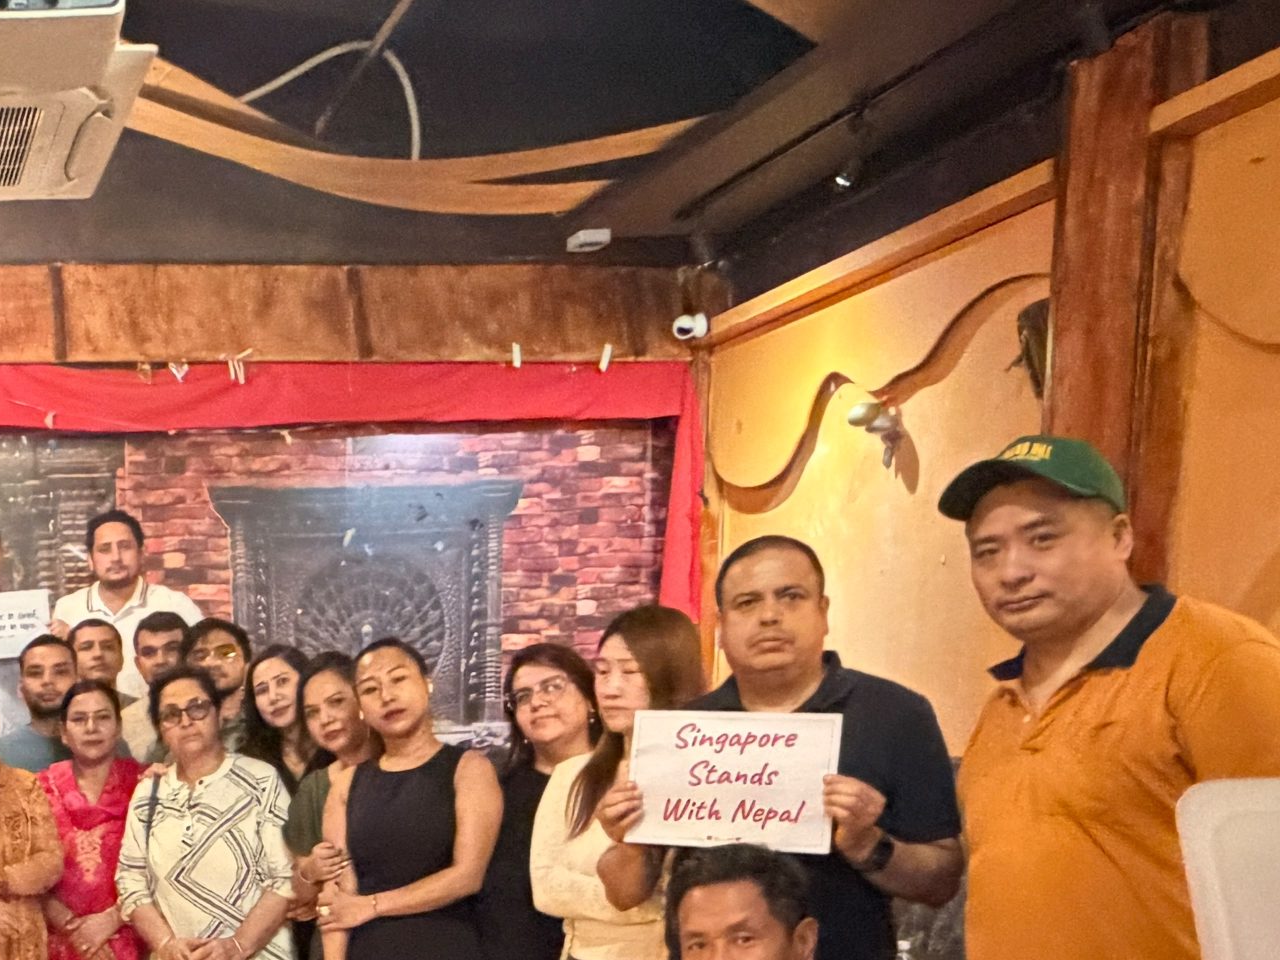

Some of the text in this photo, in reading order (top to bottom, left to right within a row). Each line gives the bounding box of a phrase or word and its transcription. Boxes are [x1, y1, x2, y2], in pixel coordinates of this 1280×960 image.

[675, 723, 798, 755] Singapore
[688, 760, 779, 787] Stands
[663, 798, 806, 830] With Nepal
